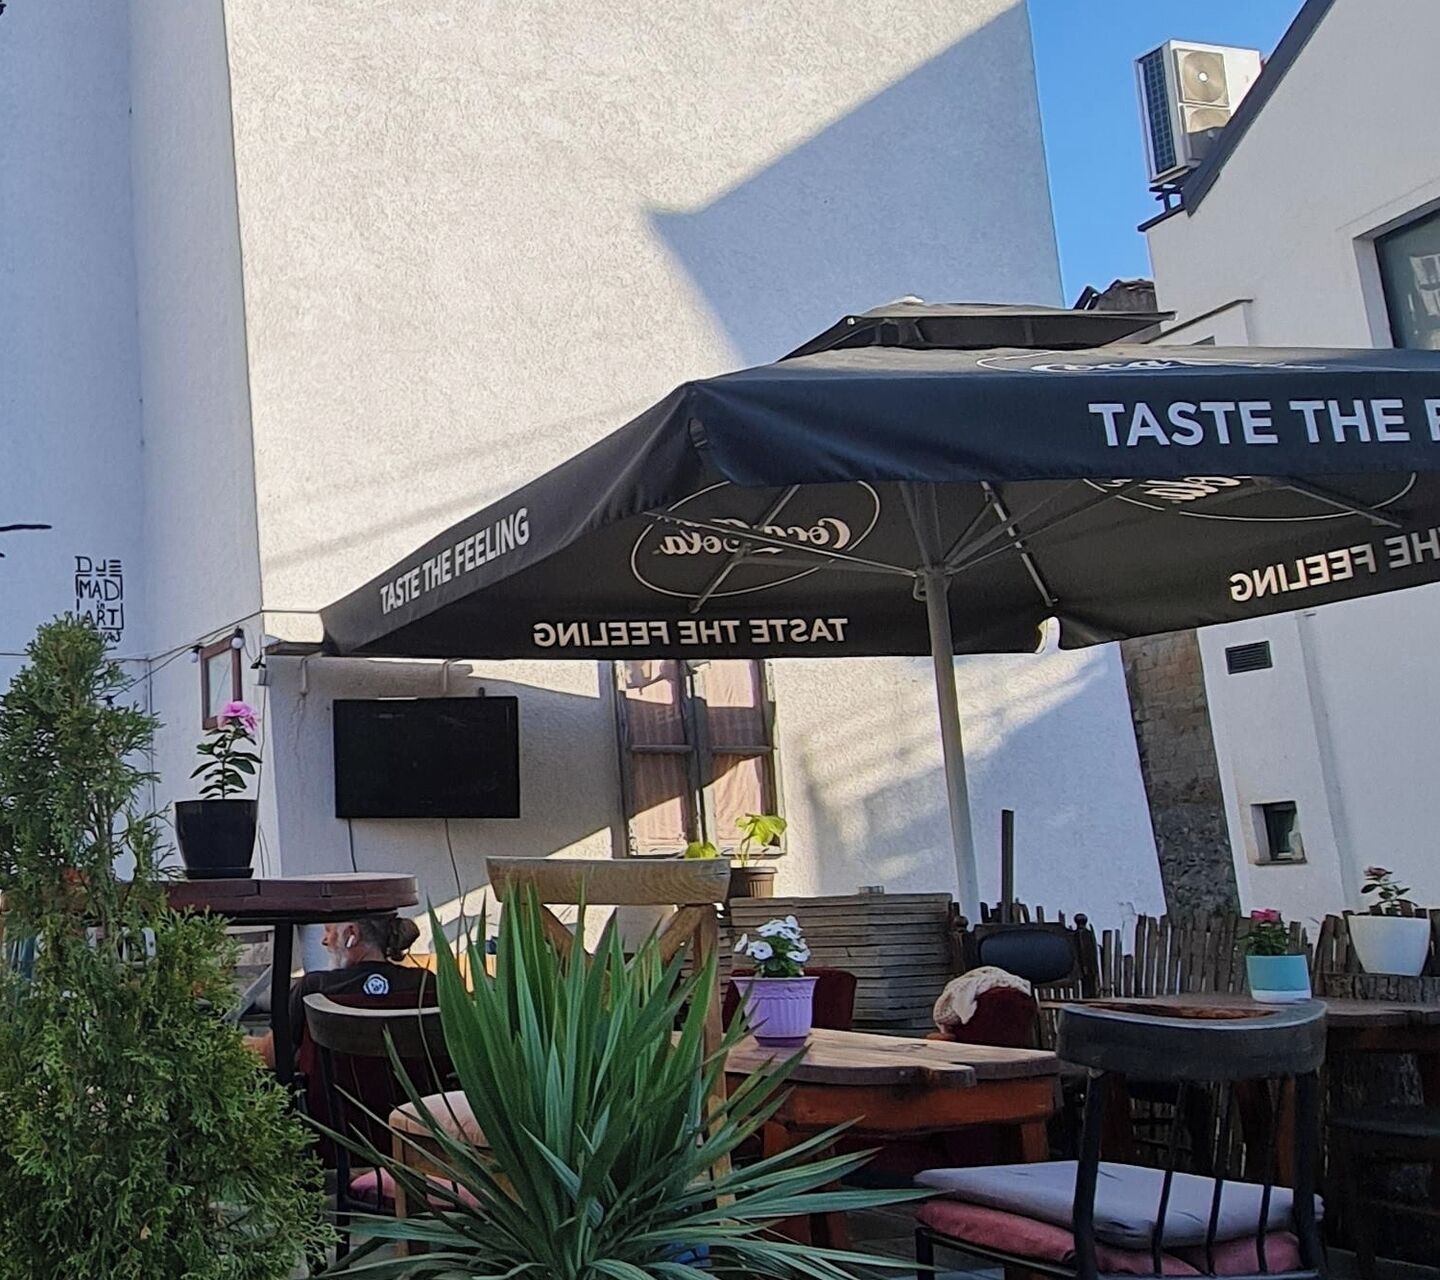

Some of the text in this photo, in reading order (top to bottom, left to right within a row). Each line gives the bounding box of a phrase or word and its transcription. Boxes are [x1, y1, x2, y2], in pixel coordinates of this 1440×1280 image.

[1088, 400, 1279, 447] TASTE
[1289, 398, 1410, 444] THE
[380, 507, 530, 615] TASTE THE FEELING
[80, 579, 120, 601] MAD
[96, 600, 105, 609] in
[84, 609, 119, 626] ART
